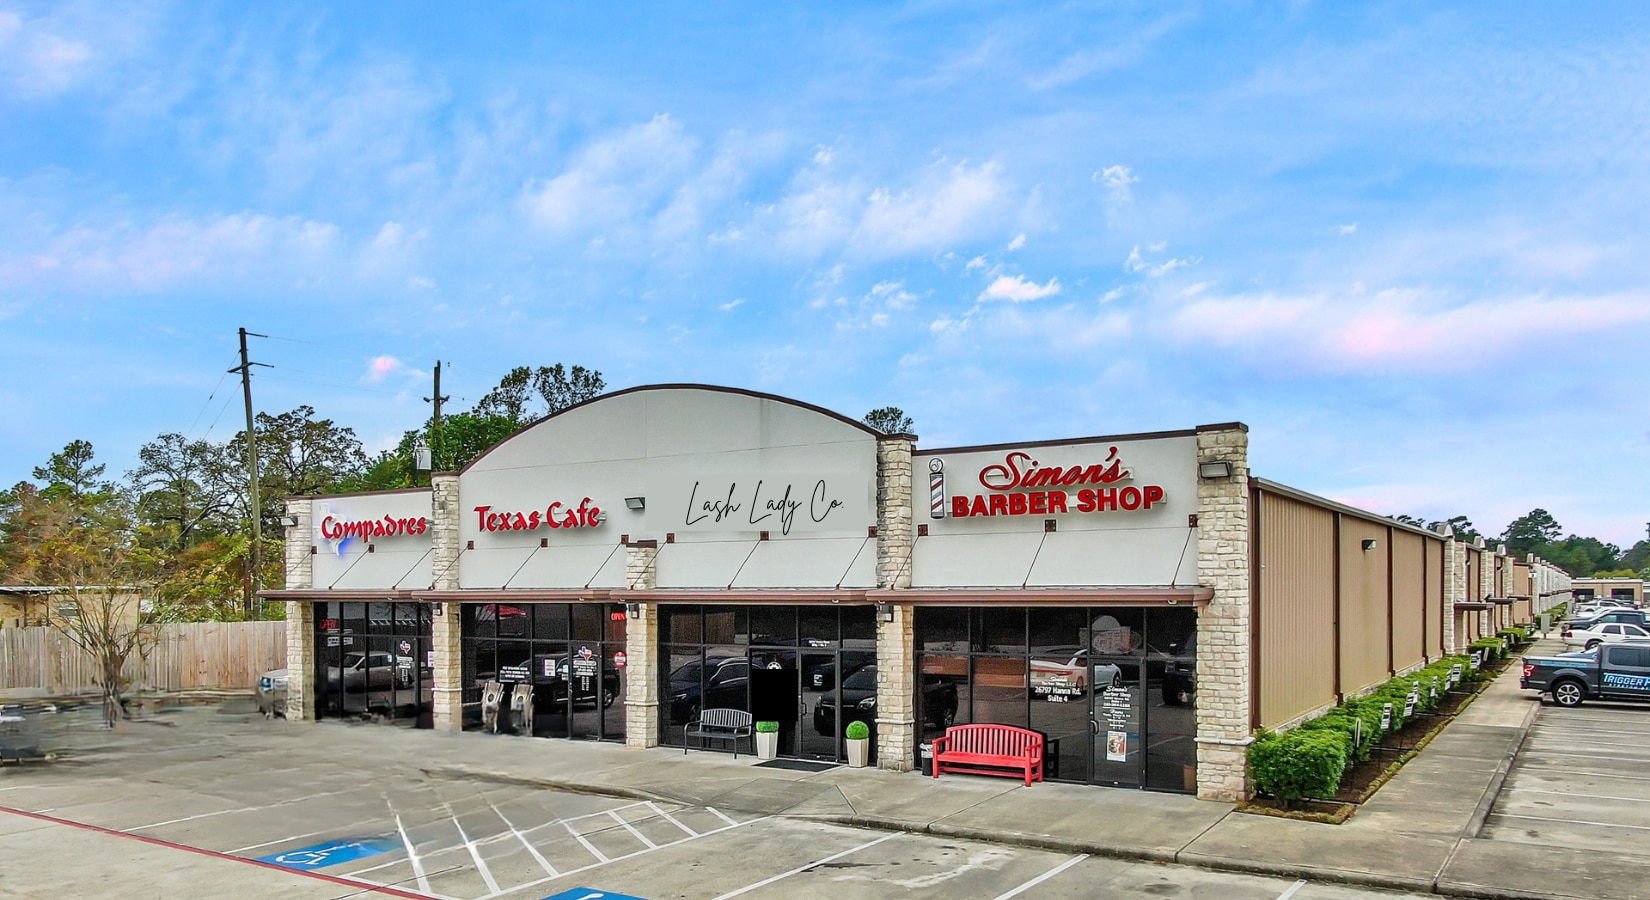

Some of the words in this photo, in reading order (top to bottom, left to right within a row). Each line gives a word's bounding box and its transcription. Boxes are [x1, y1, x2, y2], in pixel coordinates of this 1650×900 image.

[978, 446, 1130, 491] Simon's
[474, 505, 541, 532] Texas
[546, 496, 601, 529] Cafe
[685, 481, 741, 525] Lash
[749, 480, 802, 535] Lady
[810, 479, 844, 523] Co.
[952, 490, 1068, 518] BARBER
[1077, 485, 1164, 513] SHOP
[321, 514, 427, 543] Compadres
[611, 612, 626, 621] OPEN
[1603, 672, 1644, 686] TRIGGER
